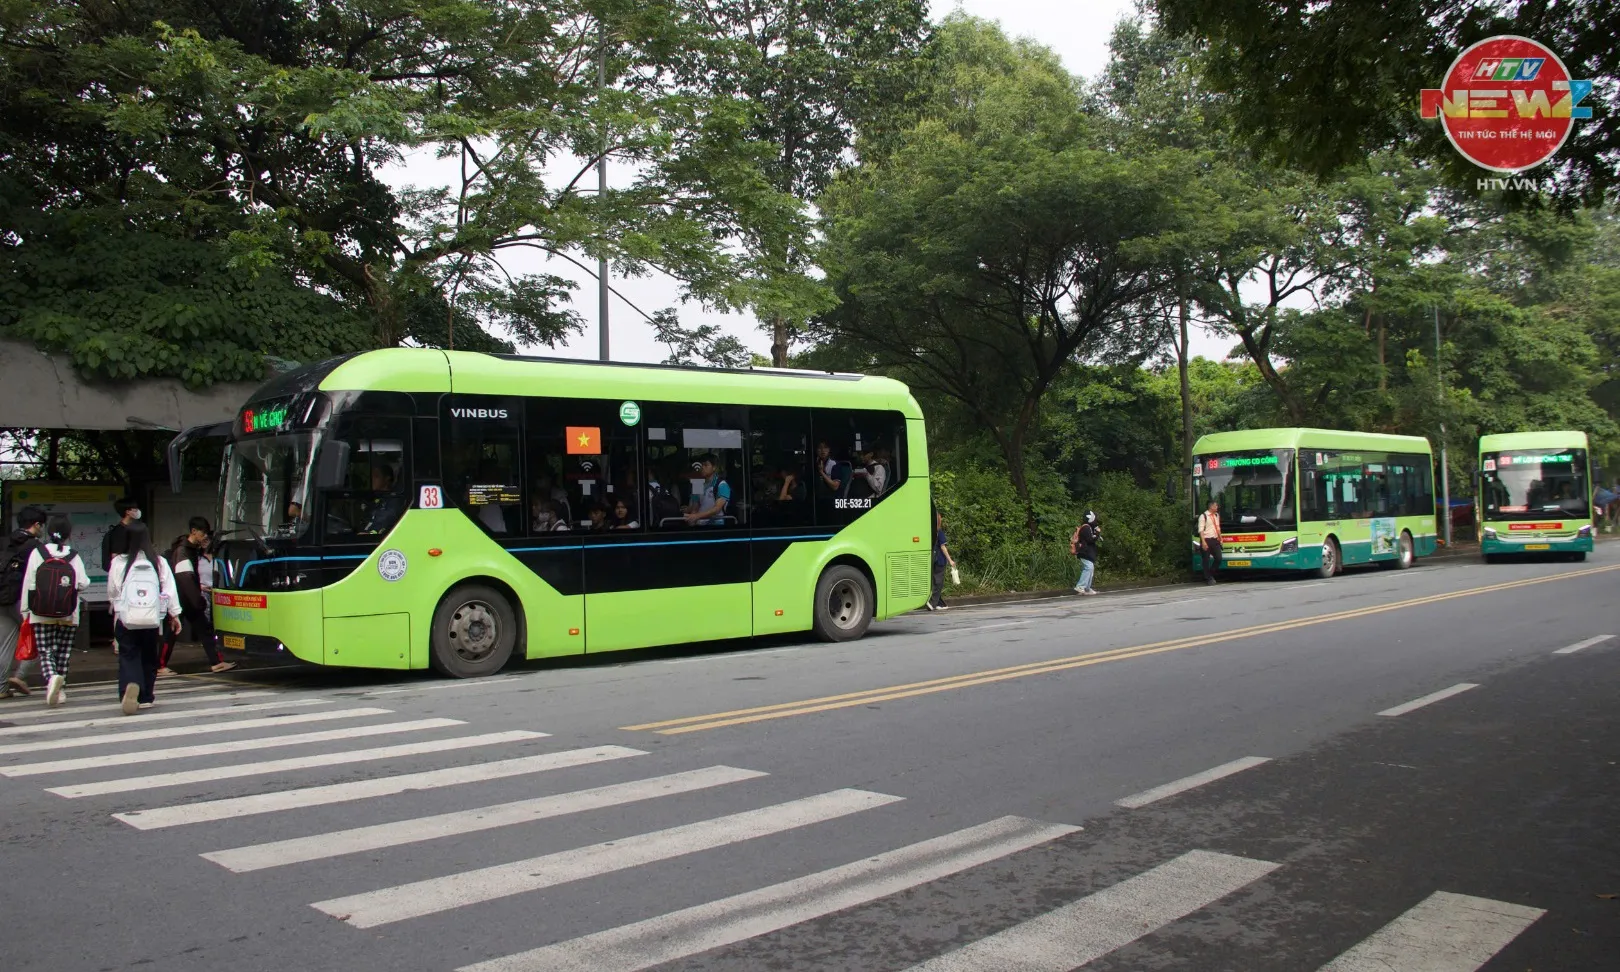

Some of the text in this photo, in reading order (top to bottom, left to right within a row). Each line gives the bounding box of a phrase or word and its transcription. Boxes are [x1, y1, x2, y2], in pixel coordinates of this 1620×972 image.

[451, 408, 508, 418] VINBUS
[424, 487, 438, 507] 33
[835, 498, 872, 508] 50E-532.21
